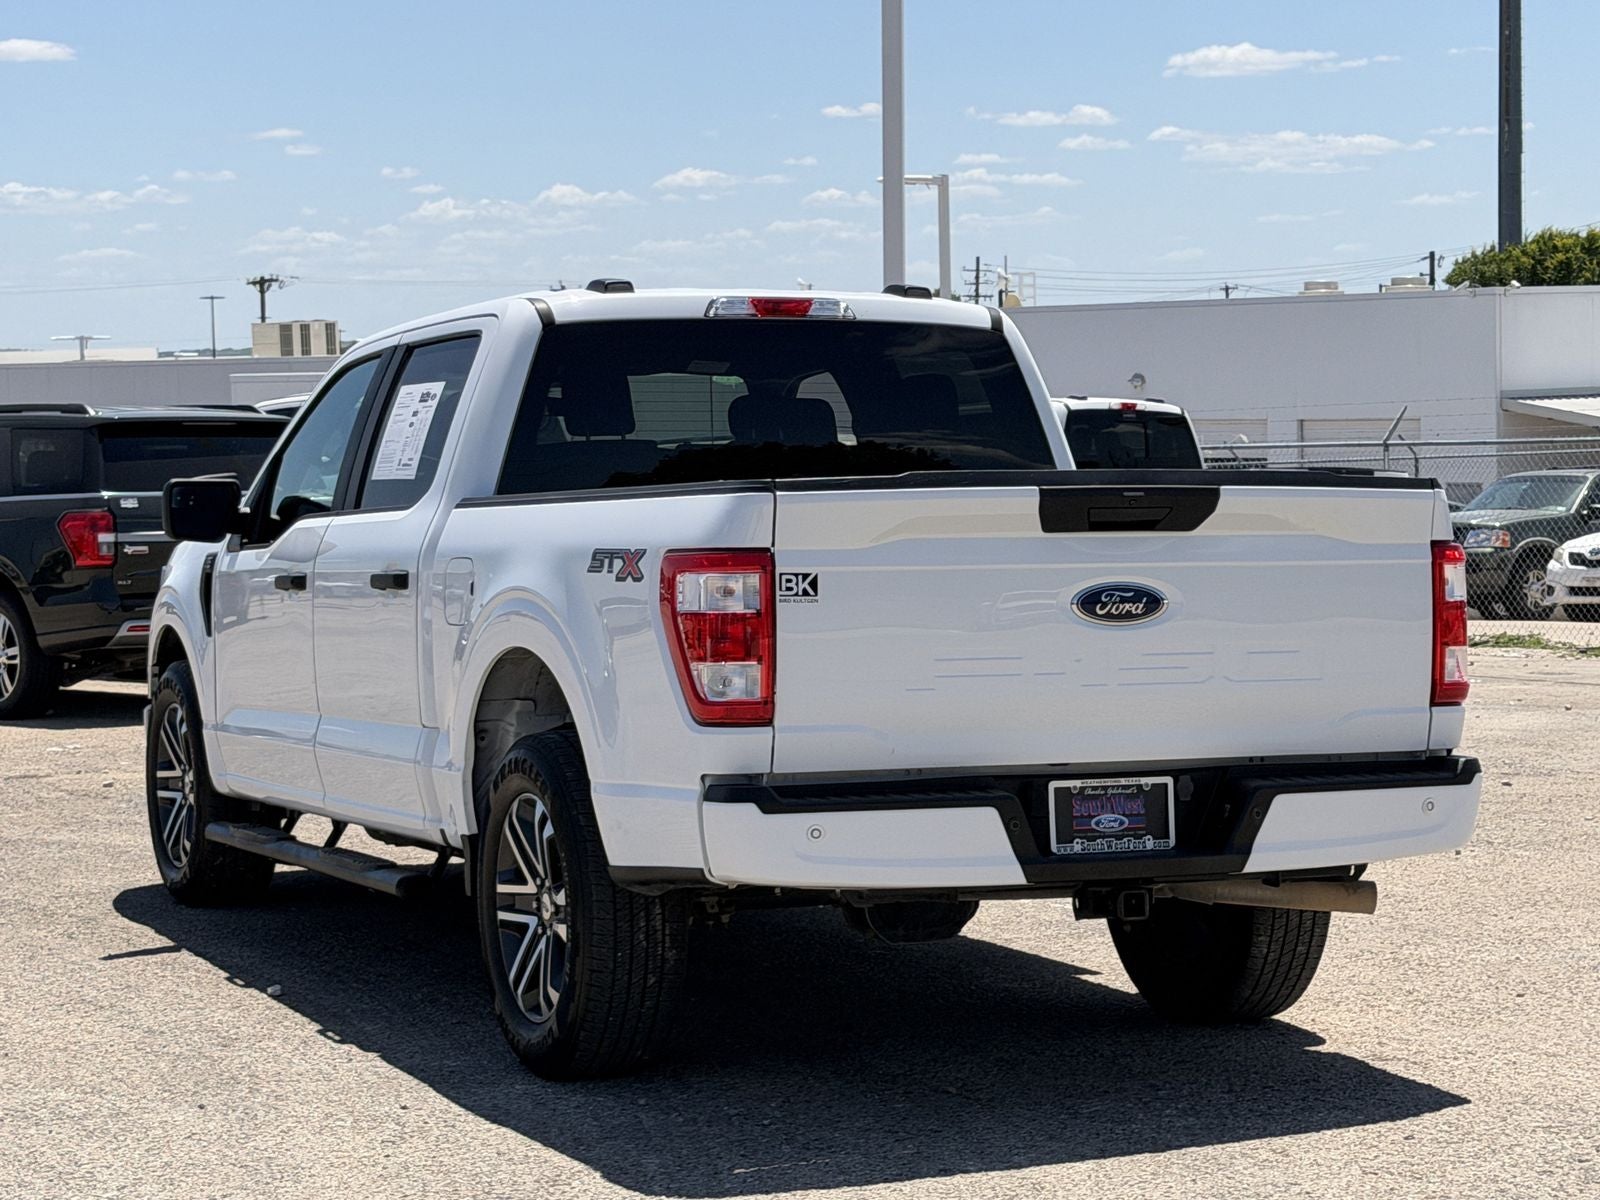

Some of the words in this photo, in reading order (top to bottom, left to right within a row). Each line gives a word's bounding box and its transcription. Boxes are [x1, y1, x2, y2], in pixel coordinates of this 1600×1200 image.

[587, 548, 647, 582] STX
[779, 573, 818, 597] BK
[1095, 590, 1147, 615] Ford
[1098, 817, 1121, 829] Ford
